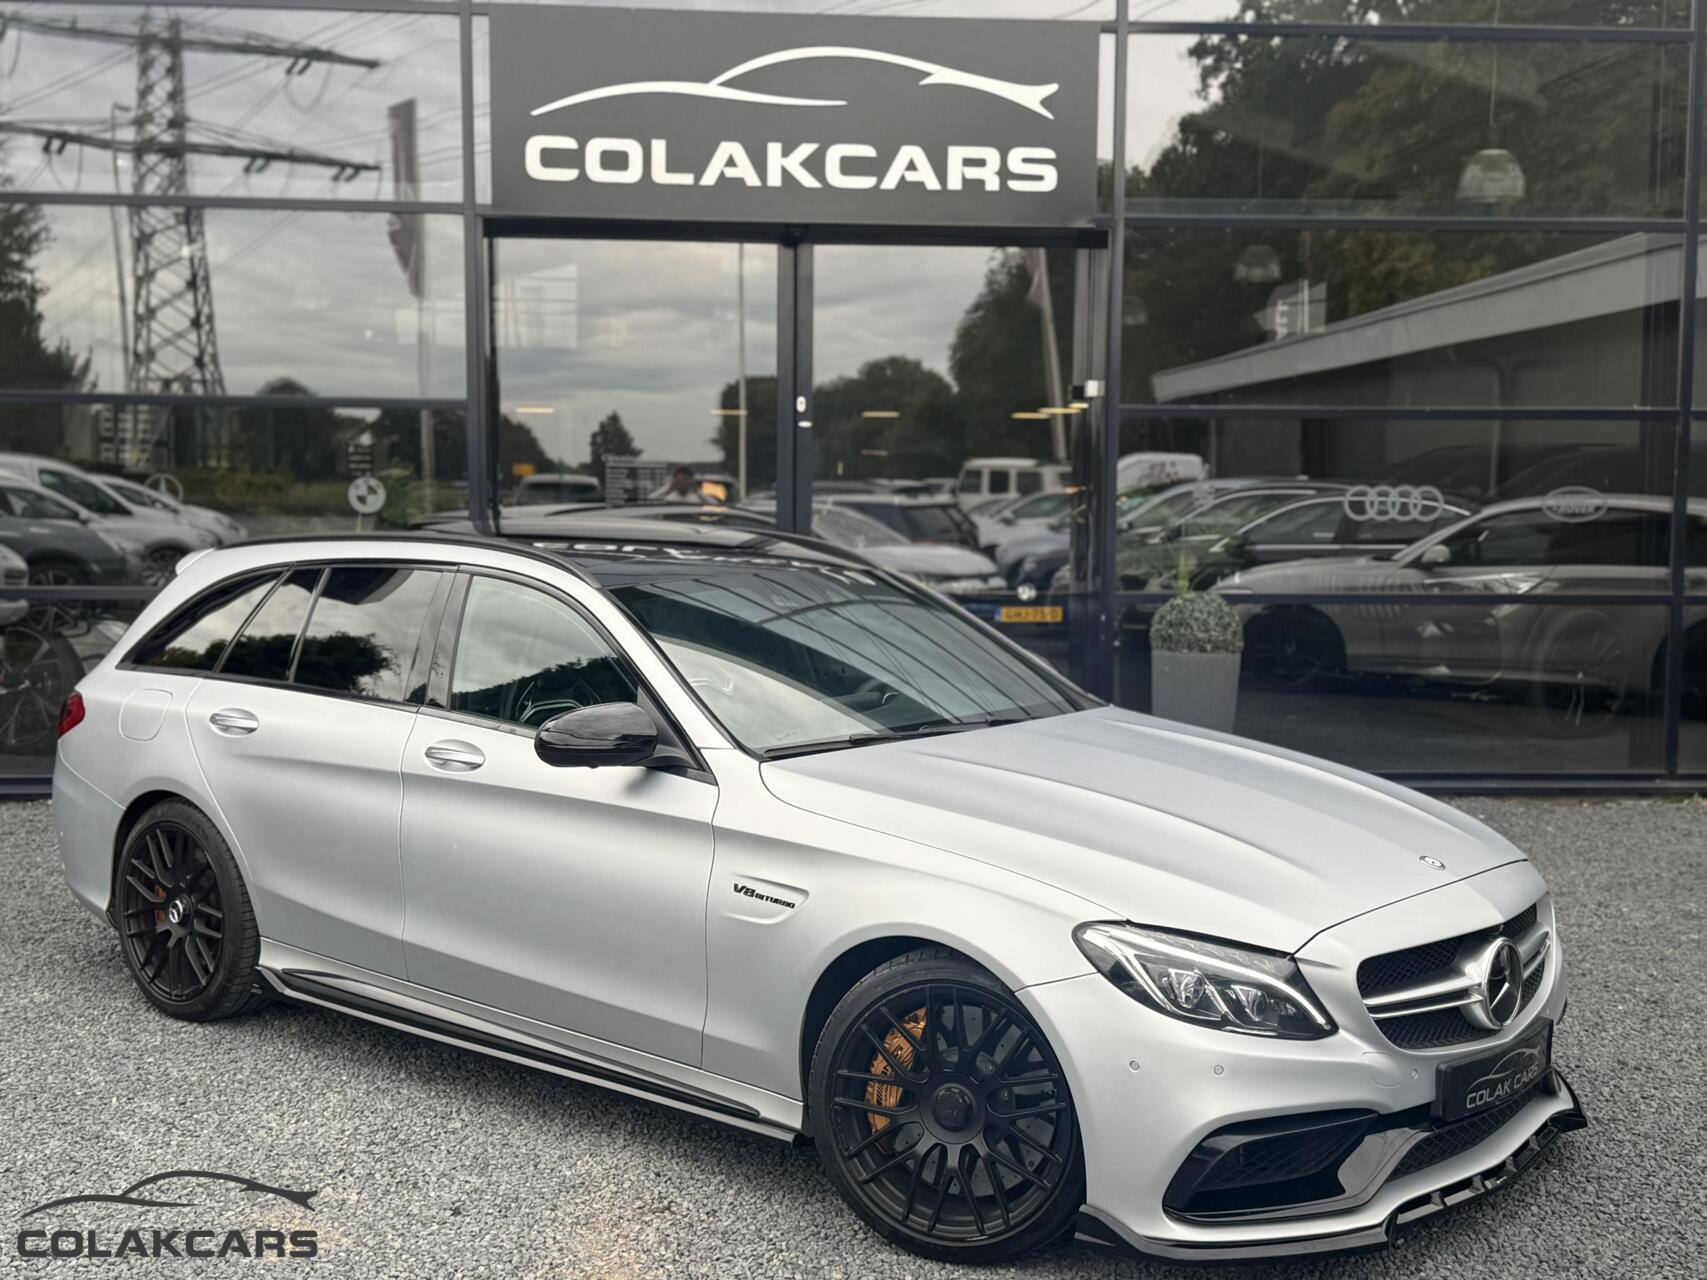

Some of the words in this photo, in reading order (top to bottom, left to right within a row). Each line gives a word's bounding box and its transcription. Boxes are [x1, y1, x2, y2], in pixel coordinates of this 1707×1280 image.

[524, 135, 1058, 193] COLAKCARS
[733, 883, 756, 898] V8
[1466, 1079, 1511, 1109] COLAK
[1513, 1064, 1539, 1089] CARS
